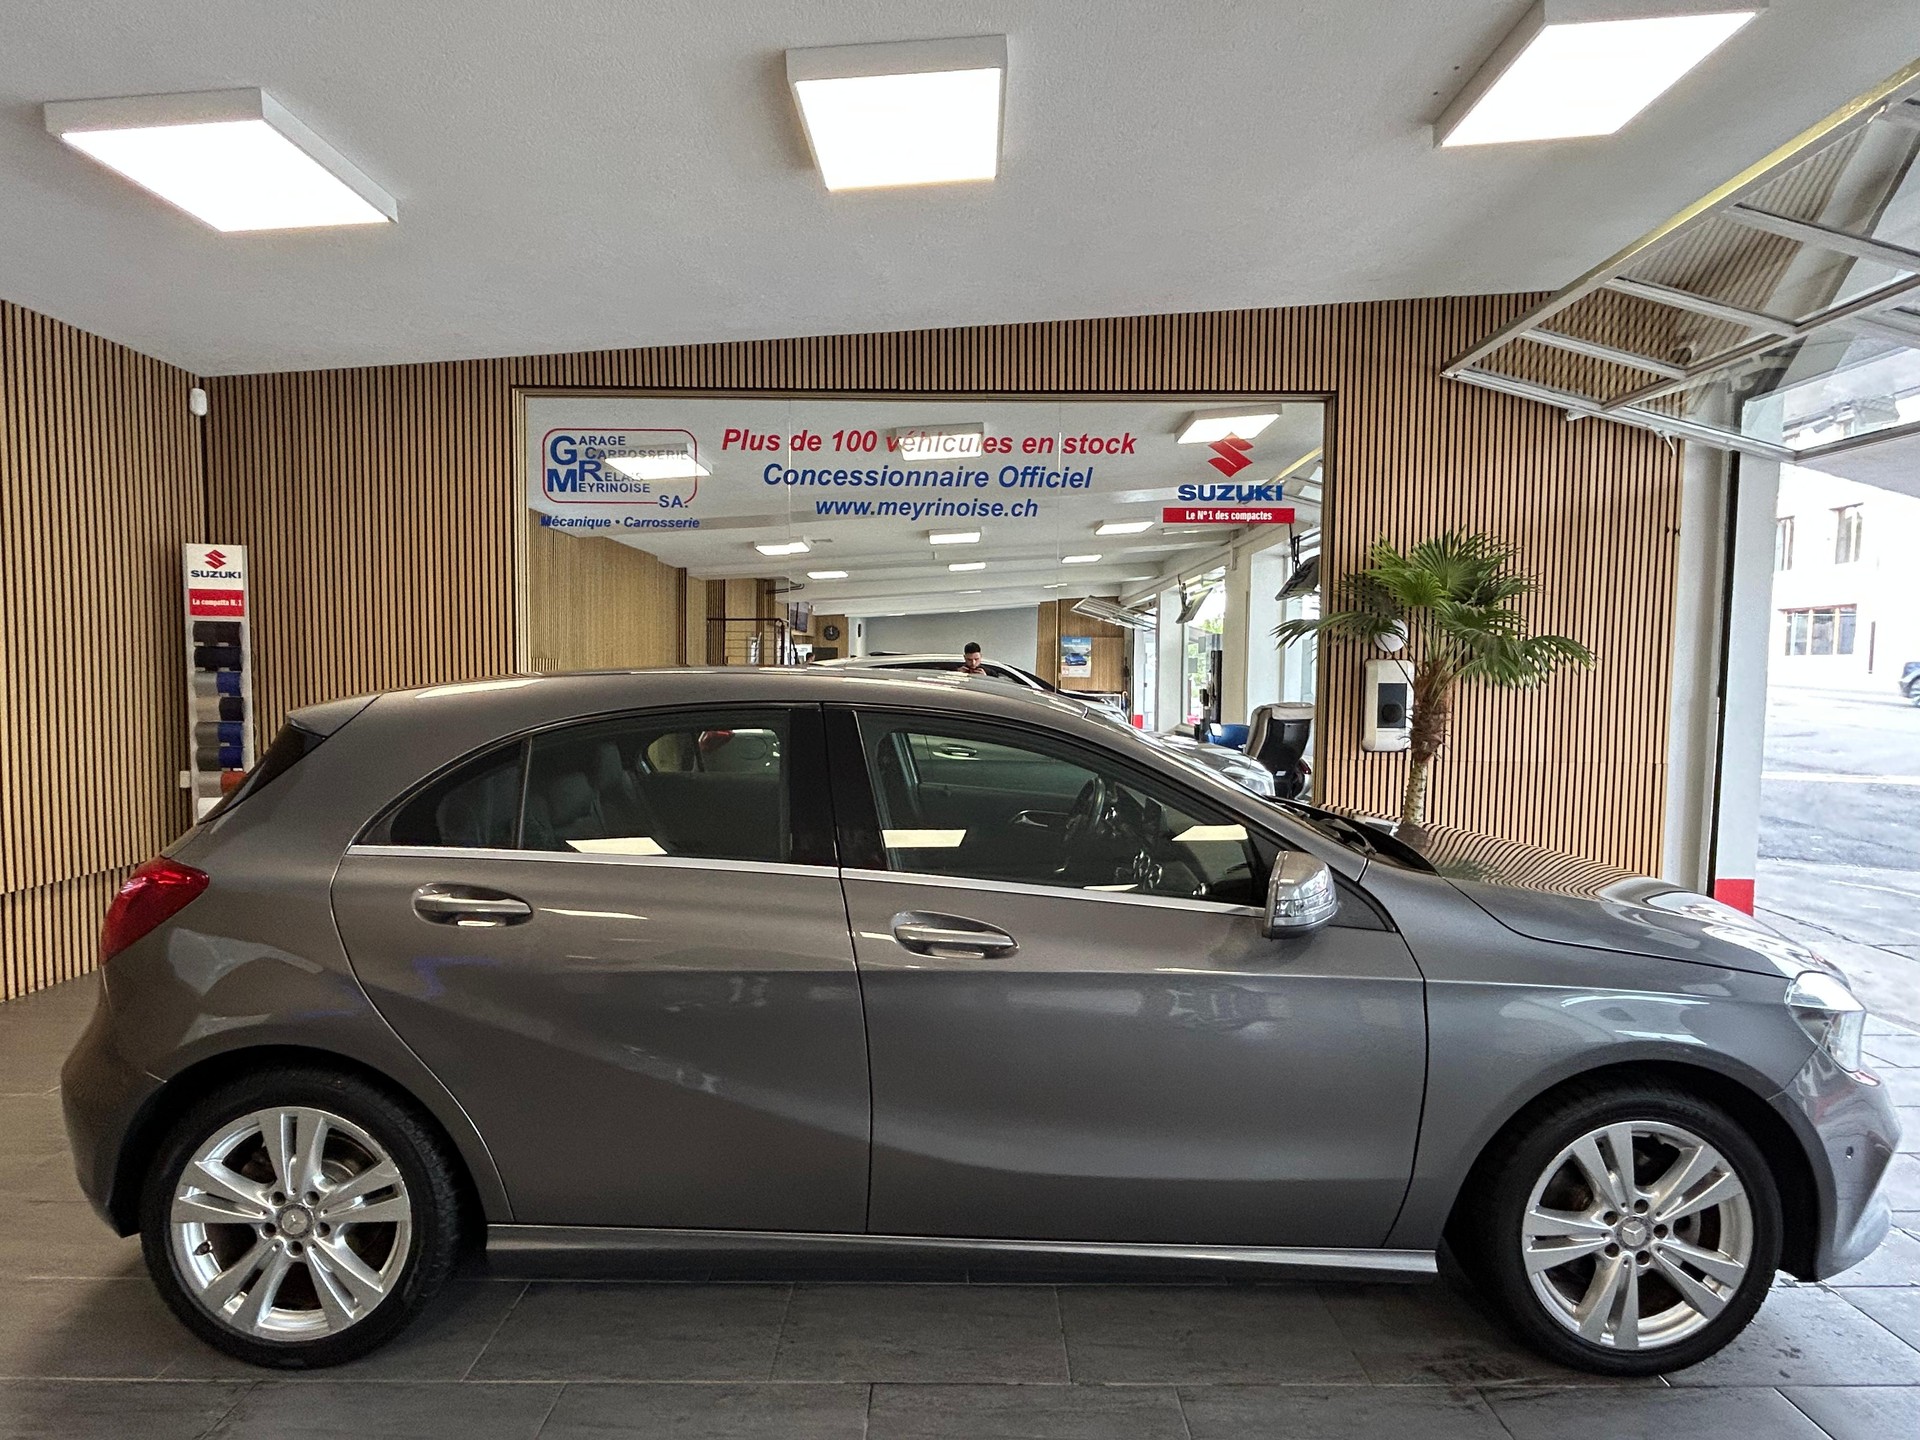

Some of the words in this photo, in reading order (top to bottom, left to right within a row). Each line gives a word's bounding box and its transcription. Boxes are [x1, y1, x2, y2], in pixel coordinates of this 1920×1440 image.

[721, 428, 782, 452] Plus
[790, 429, 823, 452] de
[831, 429, 878, 453] 100
[885, 430, 1014, 454] véhicules
[1021, 436, 1055, 454] en
[1062, 432, 1138, 455] stock
[546, 468, 651, 493] MEYRINOISE
[578, 460, 644, 482] RELA
[763, 463, 990, 488] Concessionnaire
[998, 465, 1095, 489] Officiel
[1178, 484, 1283, 501] SUZUKI
[815, 498, 1039, 522] www.meyrinoise.ch
[1185, 510, 1196, 520] Le
[1215, 510, 1229, 520] des
[1230, 510, 1273, 522] compactes
[540, 515, 612, 530] Mécanique
[623, 516, 701, 529] Carrosserie
[190, 570, 241, 578] SUZUKI
